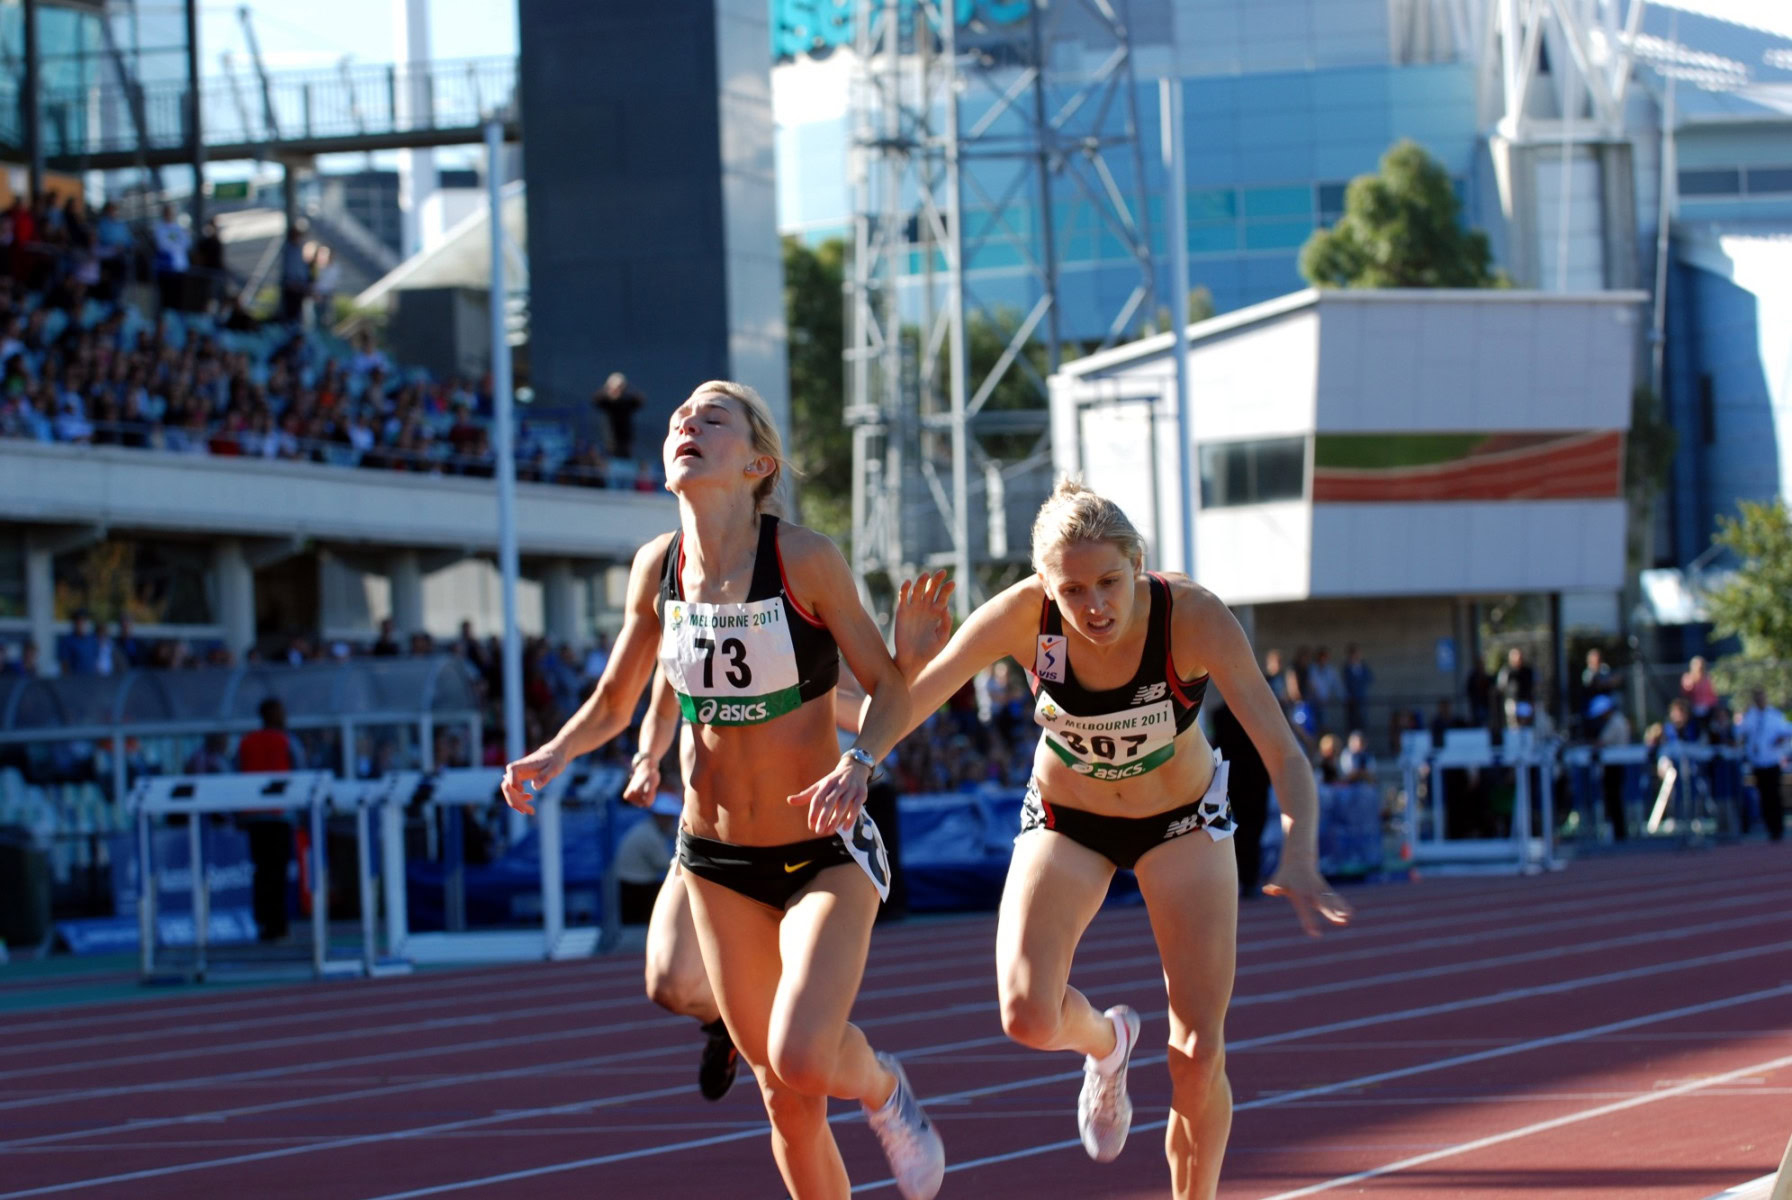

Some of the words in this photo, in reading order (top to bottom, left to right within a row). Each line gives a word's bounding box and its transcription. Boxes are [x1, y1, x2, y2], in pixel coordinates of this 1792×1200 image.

[689, 613, 749, 628] MELOURNE
[752, 609, 780, 626] 2011
[694, 637, 752, 689] 73
[1038, 670, 1058, 681] VIS
[1065, 717, 1137, 731] MELBOURNE
[1141, 711, 1168, 726] 2011
